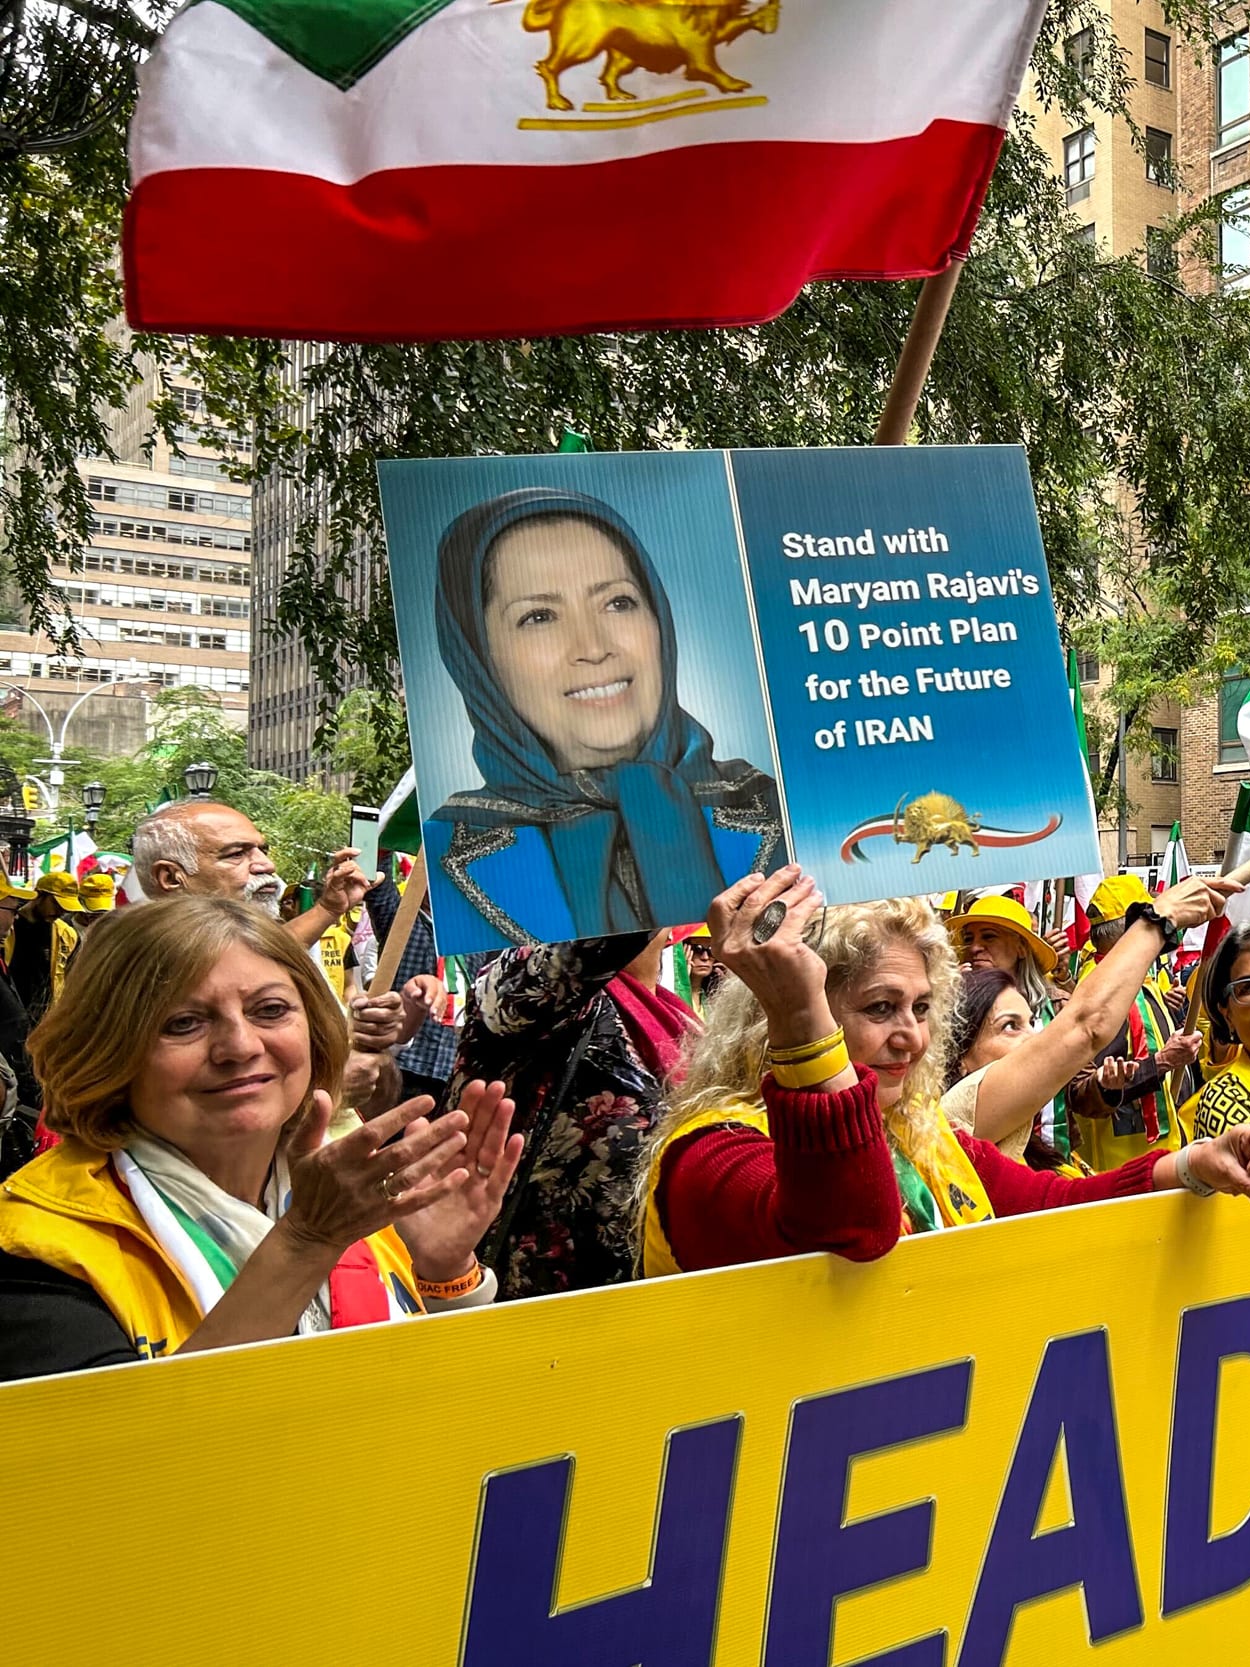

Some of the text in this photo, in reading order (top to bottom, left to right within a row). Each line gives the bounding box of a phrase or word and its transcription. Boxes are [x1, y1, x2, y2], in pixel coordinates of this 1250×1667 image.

[782, 526, 949, 558] Stand with
[790, 569, 1040, 609] Maryam Rajavi's
[798, 617, 1017, 653] 10 Point Plan
[805, 666, 1011, 701] for the Future
[814, 715, 934, 750] of IRAN
[443, 1278, 473, 1293] FREE
